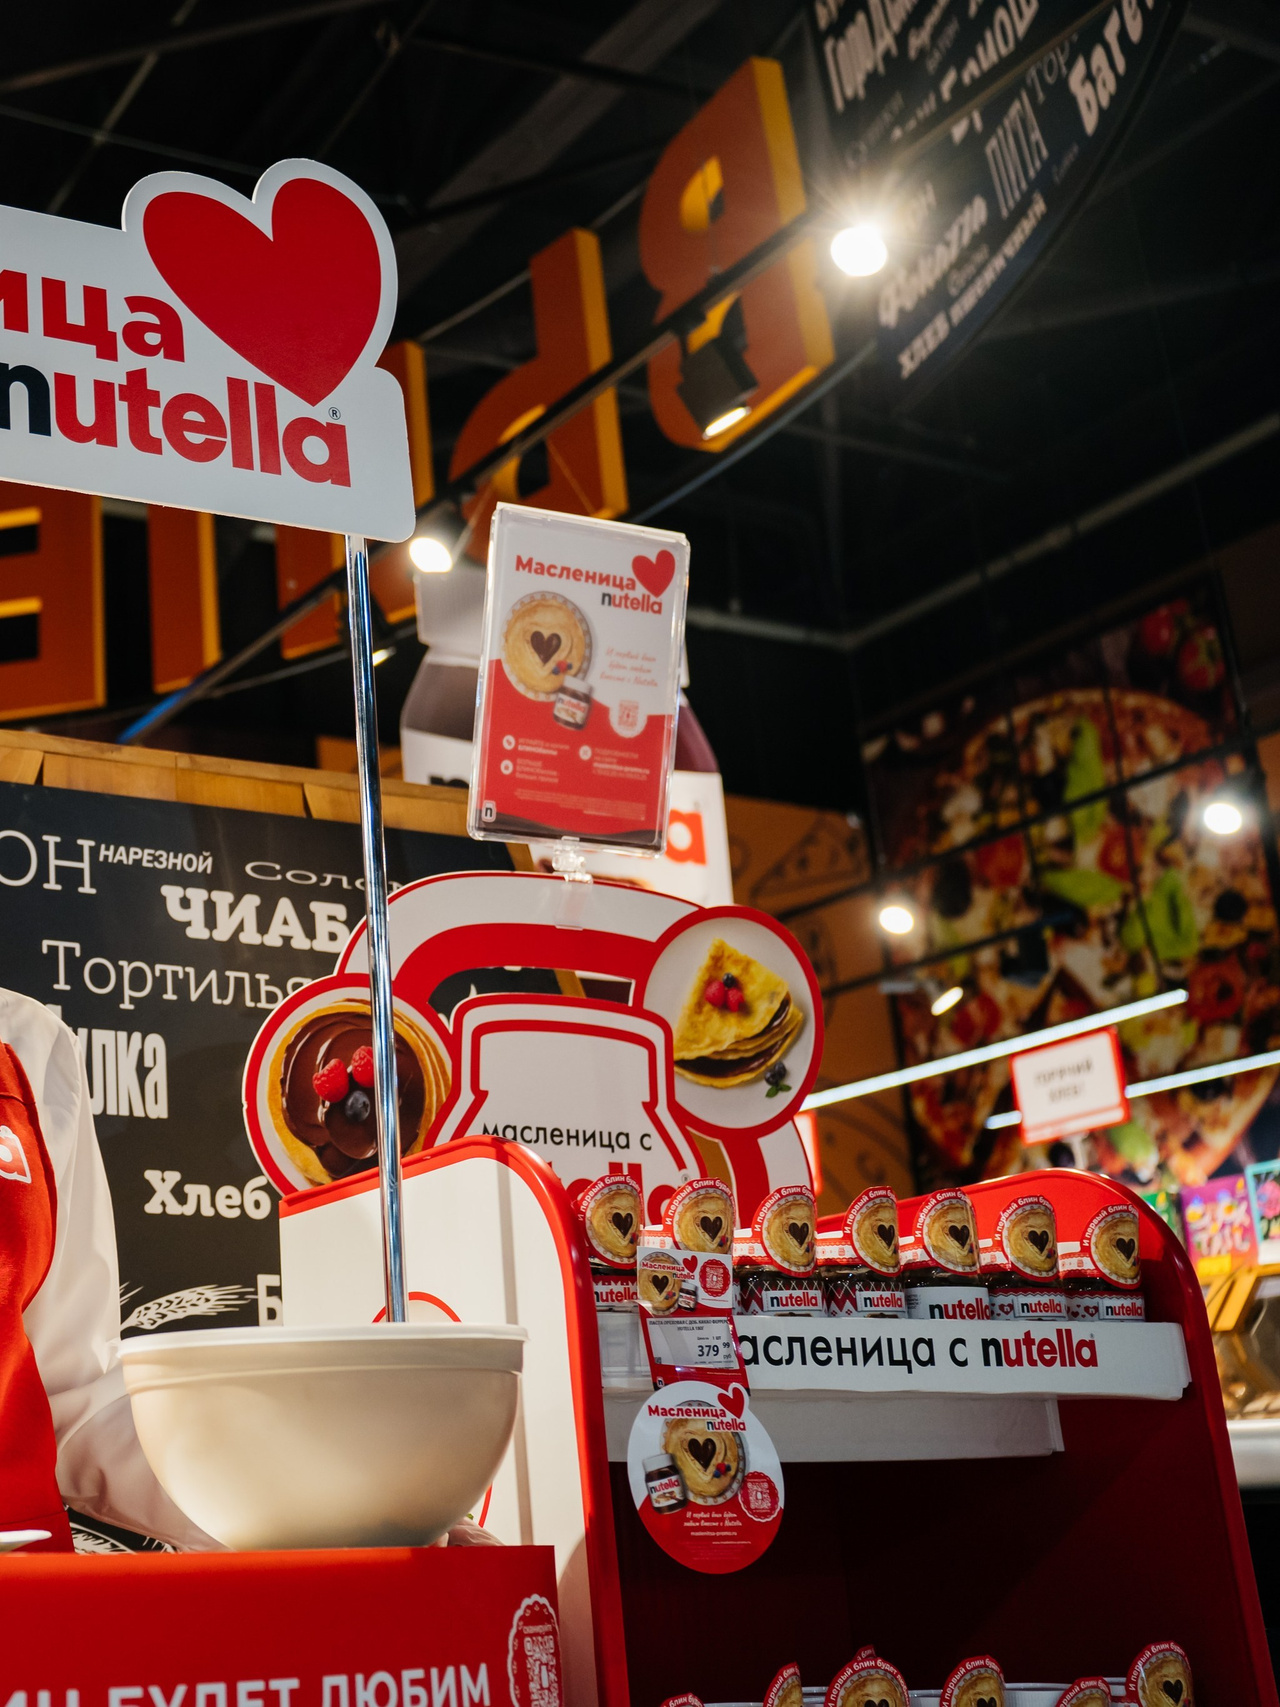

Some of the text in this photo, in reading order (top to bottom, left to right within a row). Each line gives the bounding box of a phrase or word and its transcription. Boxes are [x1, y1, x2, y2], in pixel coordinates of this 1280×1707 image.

[1068, 0, 1154, 137] Баге
[515, 555, 637, 591] Масленица
[601, 592, 662, 615] nutella
[99, 844, 213, 875] НАРЕЗНОЙ
[245, 861, 405, 893] Сол
[160, 885, 351, 954] ЧИАБ
[69, 1026, 168, 1119] улка
[482, 1123, 652, 1153] масленица с
[144, 1169, 272, 1219] Хлеб
[641, 1261, 685, 1272] Масленица
[672, 1272, 695, 1280] nutella
[770, 1292, 818, 1308] nutella
[864, 1293, 902, 1308] nutella
[1021, 1299, 1062, 1313] nutella
[1106, 1302, 1142, 1317] nutella
[697, 1344, 719, 1357] 379
[738, 1328, 1098, 1375] асленица с nutella
[647, 1404, 726, 1418] Масленица
[706, 1418, 746, 1431] nutella
[650, 1478, 680, 1494] nutella
[322, 1663, 490, 1707] ЛЮБИМ
[831, 1667, 853, 1700] первый
[853, 1659, 875, 1674] блин
[945, 1667, 966, 1700] первый
[966, 1658, 984, 1670] блин
